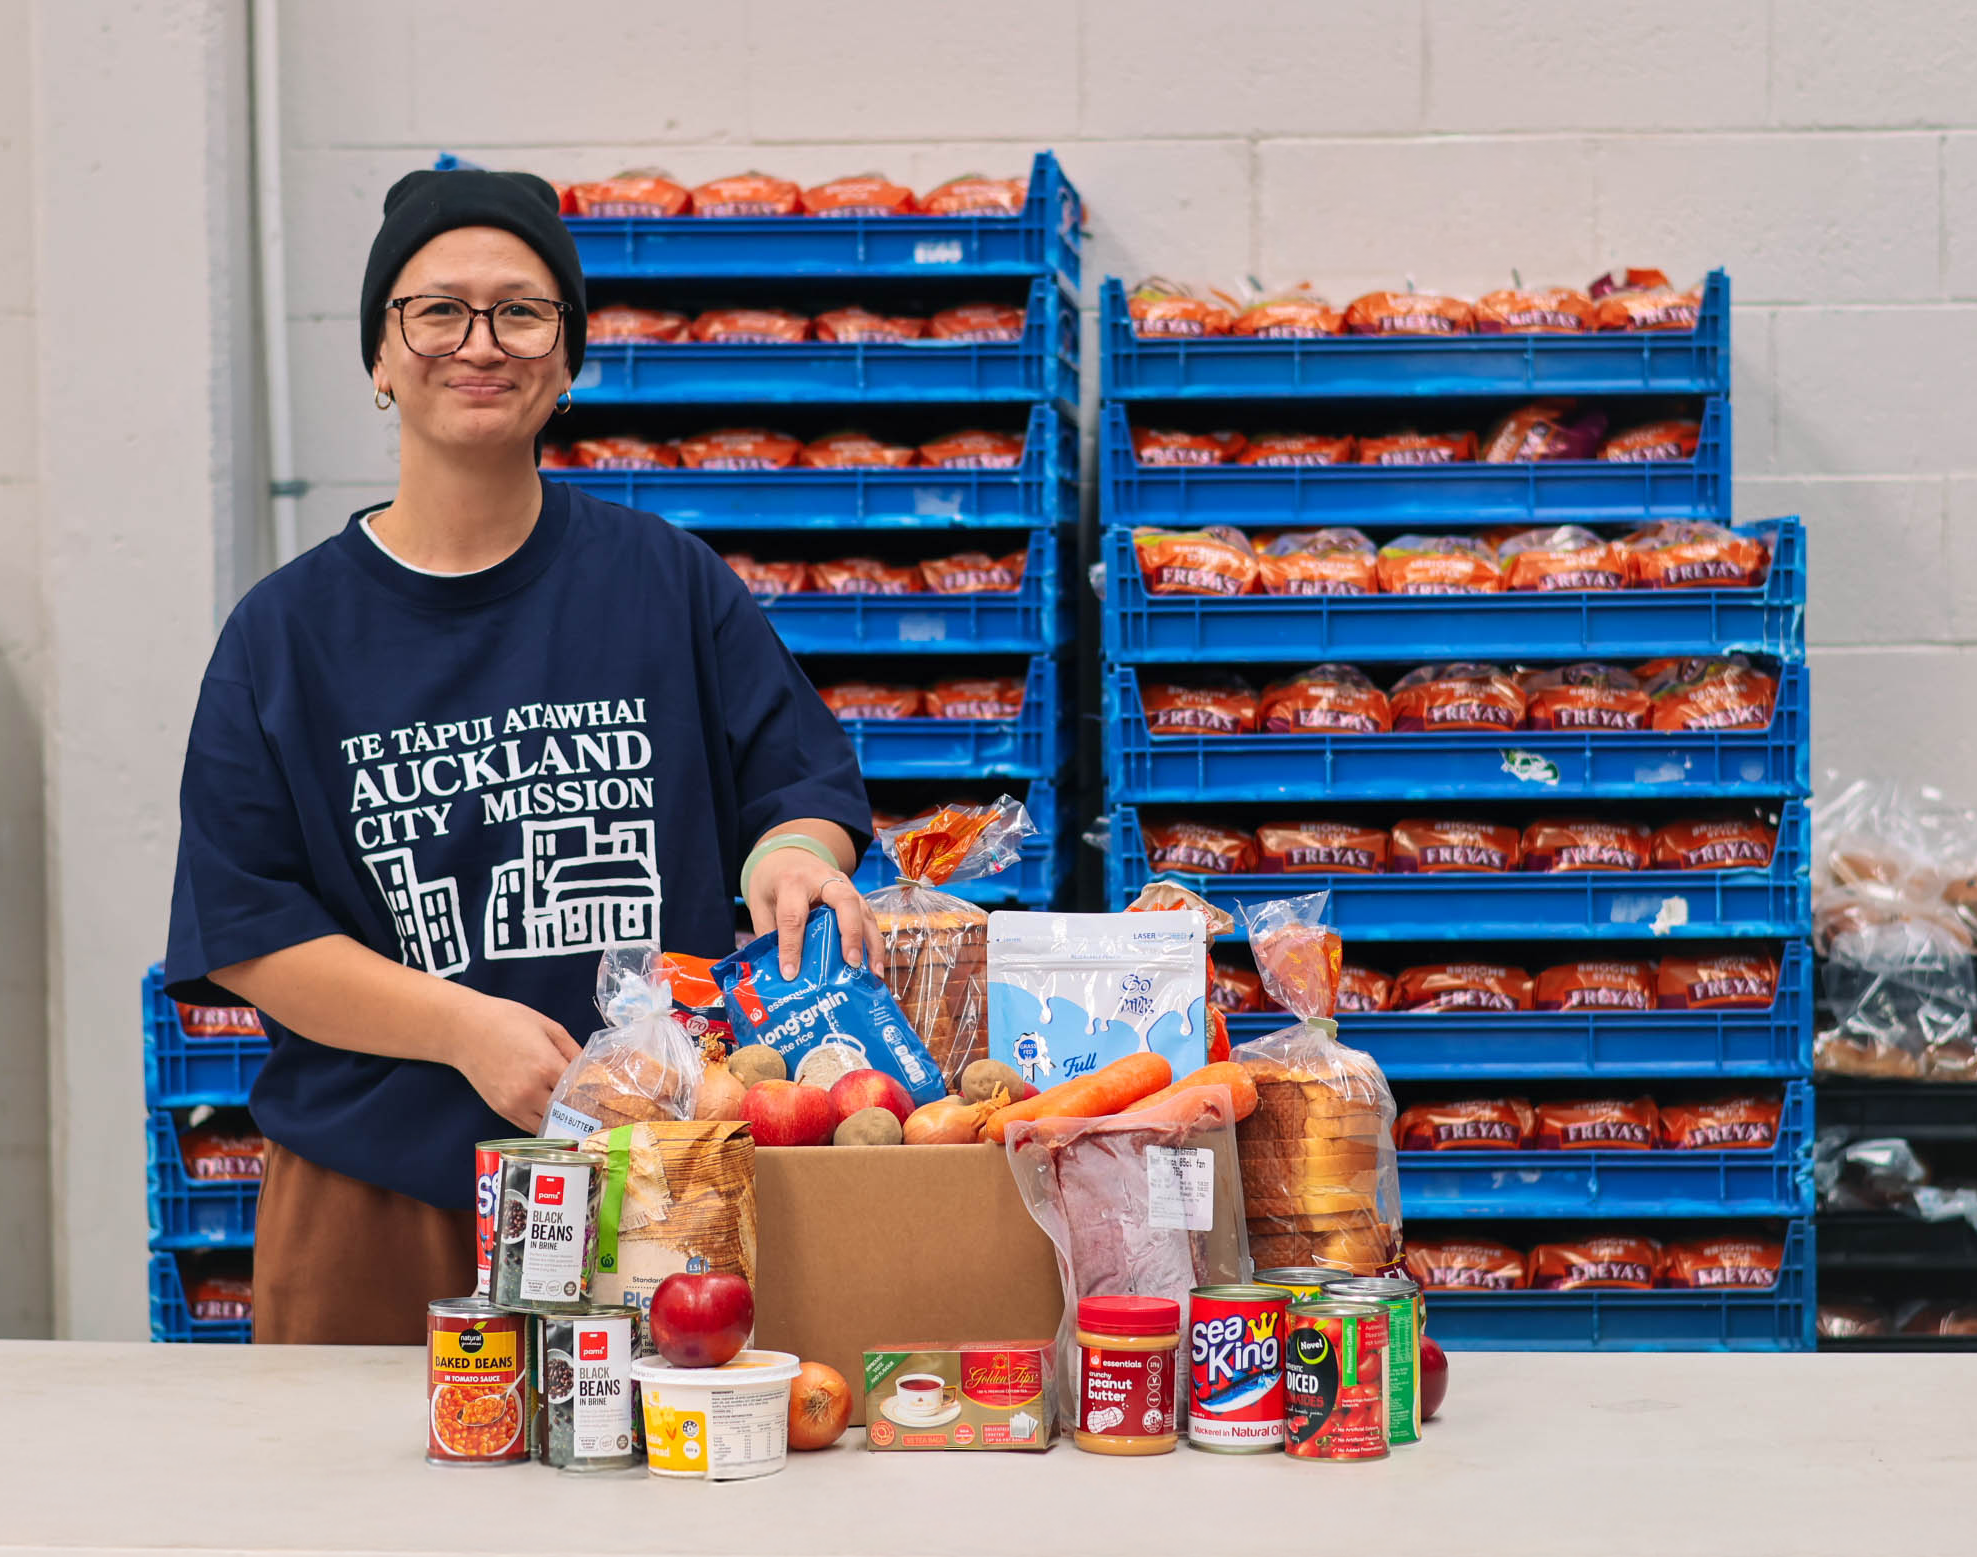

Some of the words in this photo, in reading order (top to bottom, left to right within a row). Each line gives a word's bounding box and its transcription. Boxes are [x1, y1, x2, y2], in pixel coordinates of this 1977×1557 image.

[341, 734, 384, 765] TE
[391, 716, 494, 756] TĀPUI
[503, 698, 647, 735] ATAWHAI
[350, 730, 652, 813] AUCKLAND
[355, 803, 452, 850] CITY
[481, 777, 654, 825] MISSION
[1292, 848, 1370, 866] FREYA'S
[1133, 932, 1156, 940] LASER
[192, 1008, 257, 1026] FREYA
[757, 1016, 801, 1045] long
[800, 992, 849, 1027] grain
[795, 1031, 815, 1045] rice
[1063, 1052, 1097, 1077] Full
[568, 1117, 595, 1134] BUTTER
[1439, 1124, 1514, 1143] FREYA'S
[1567, 1124, 1645, 1144] FREYA'S
[195, 1157, 262, 1176] FREYA
[538, 1192, 559, 1200] pams
[533, 1210, 564, 1224] BLACK
[531, 1223, 574, 1242] BEANS
[530, 1241, 537, 1249] IN
[539, 1242, 558, 1251] BRINE
[460, 1334, 482, 1342] natural
[1192, 1316, 1244, 1362] Sea
[1300, 1339, 1324, 1350] Novel
[583, 1348, 604, 1356] pams
[1209, 1337, 1278, 1382] King
[435, 1356, 470, 1369] BAKED
[475, 1356, 513, 1369] BEANS
[1102, 1360, 1142, 1368] essentials
[452, 1375, 479, 1383] TOMATO
[579, 1367, 610, 1379] BLACK
[965, 1367, 1009, 1389] Golden
[1009, 1367, 1036, 1388] Tips
[1089, 1371, 1112, 1380] crunchy
[579, 1379, 621, 1397] BEANS
[1088, 1378, 1133, 1392] peanut
[1286, 1370, 1319, 1394] DICED
[580, 1398, 586, 1406] IN
[588, 1397, 607, 1406] BRINE
[1088, 1390, 1127, 1402] butter
[1223, 1428, 1230, 1437] in
[1231, 1426, 1270, 1437] Natural
[1271, 1424, 1283, 1436] Oil
